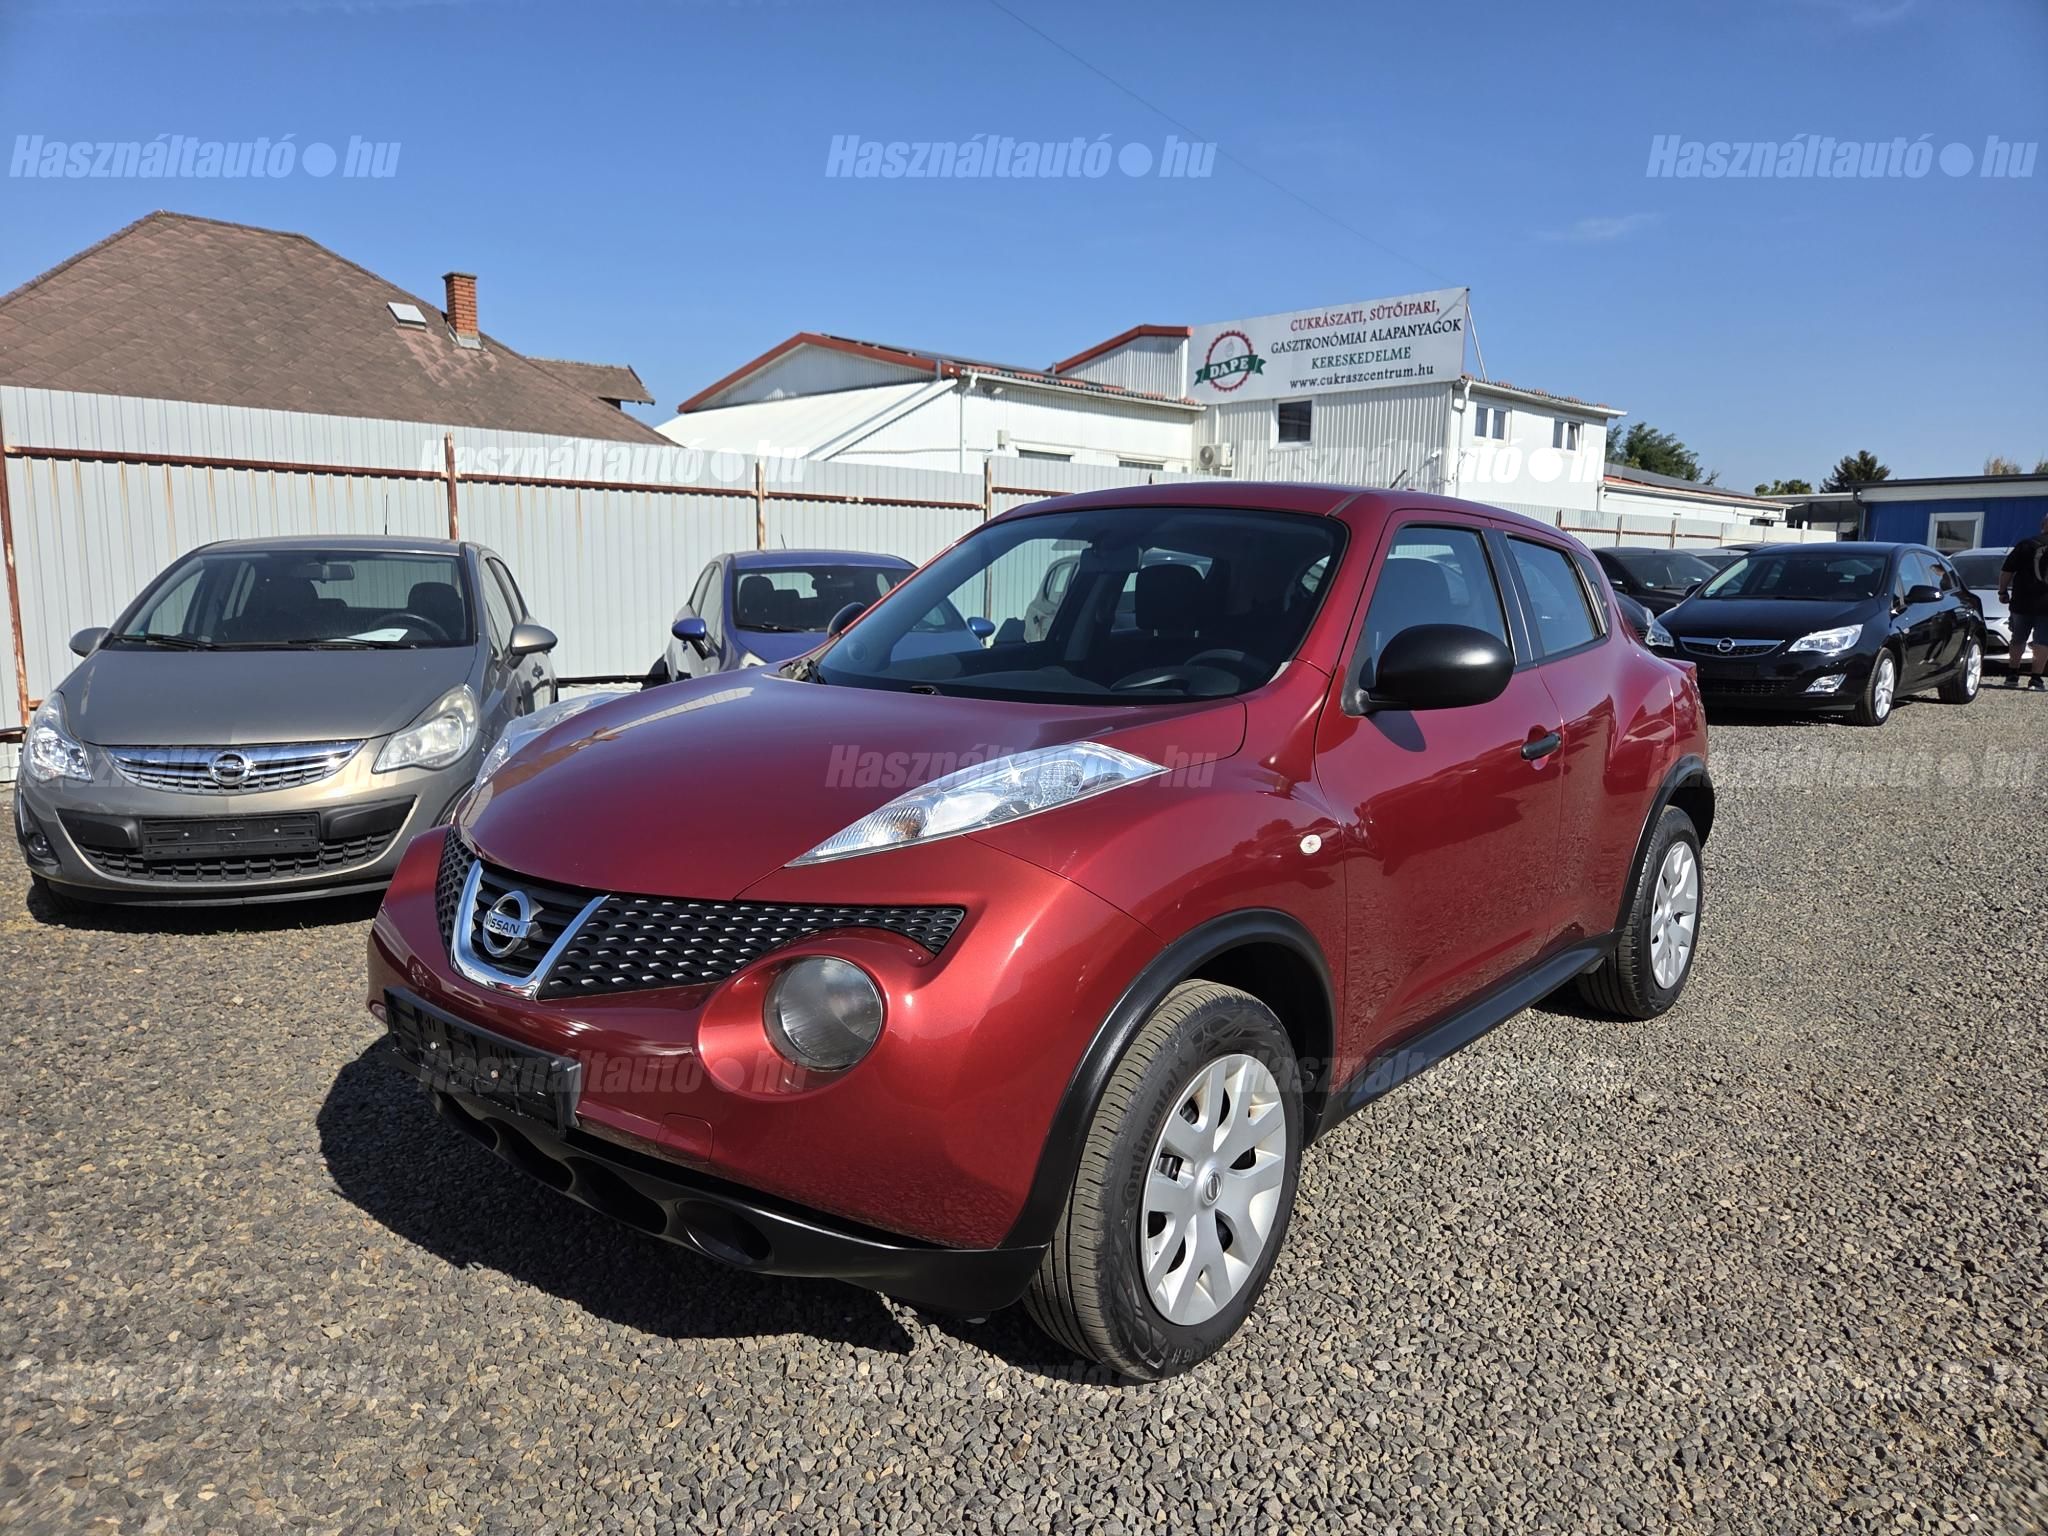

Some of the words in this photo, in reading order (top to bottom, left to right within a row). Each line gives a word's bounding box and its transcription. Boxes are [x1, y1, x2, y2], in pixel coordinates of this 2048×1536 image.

[1290, 311, 1367, 332] CUKRÁSZATI,
[1369, 300, 1440, 321] SÜTŐIPARI,
[1271, 331, 1367, 354] GASZTRONÓMIAI
[1370, 319, 1462, 342] ALAPANYAGOK
[1210, 358, 1249, 378] DAPE
[1311, 346, 1411, 370] KERESKEDELME
[1290, 364, 1434, 389] www.cukraszcentrum.hu
